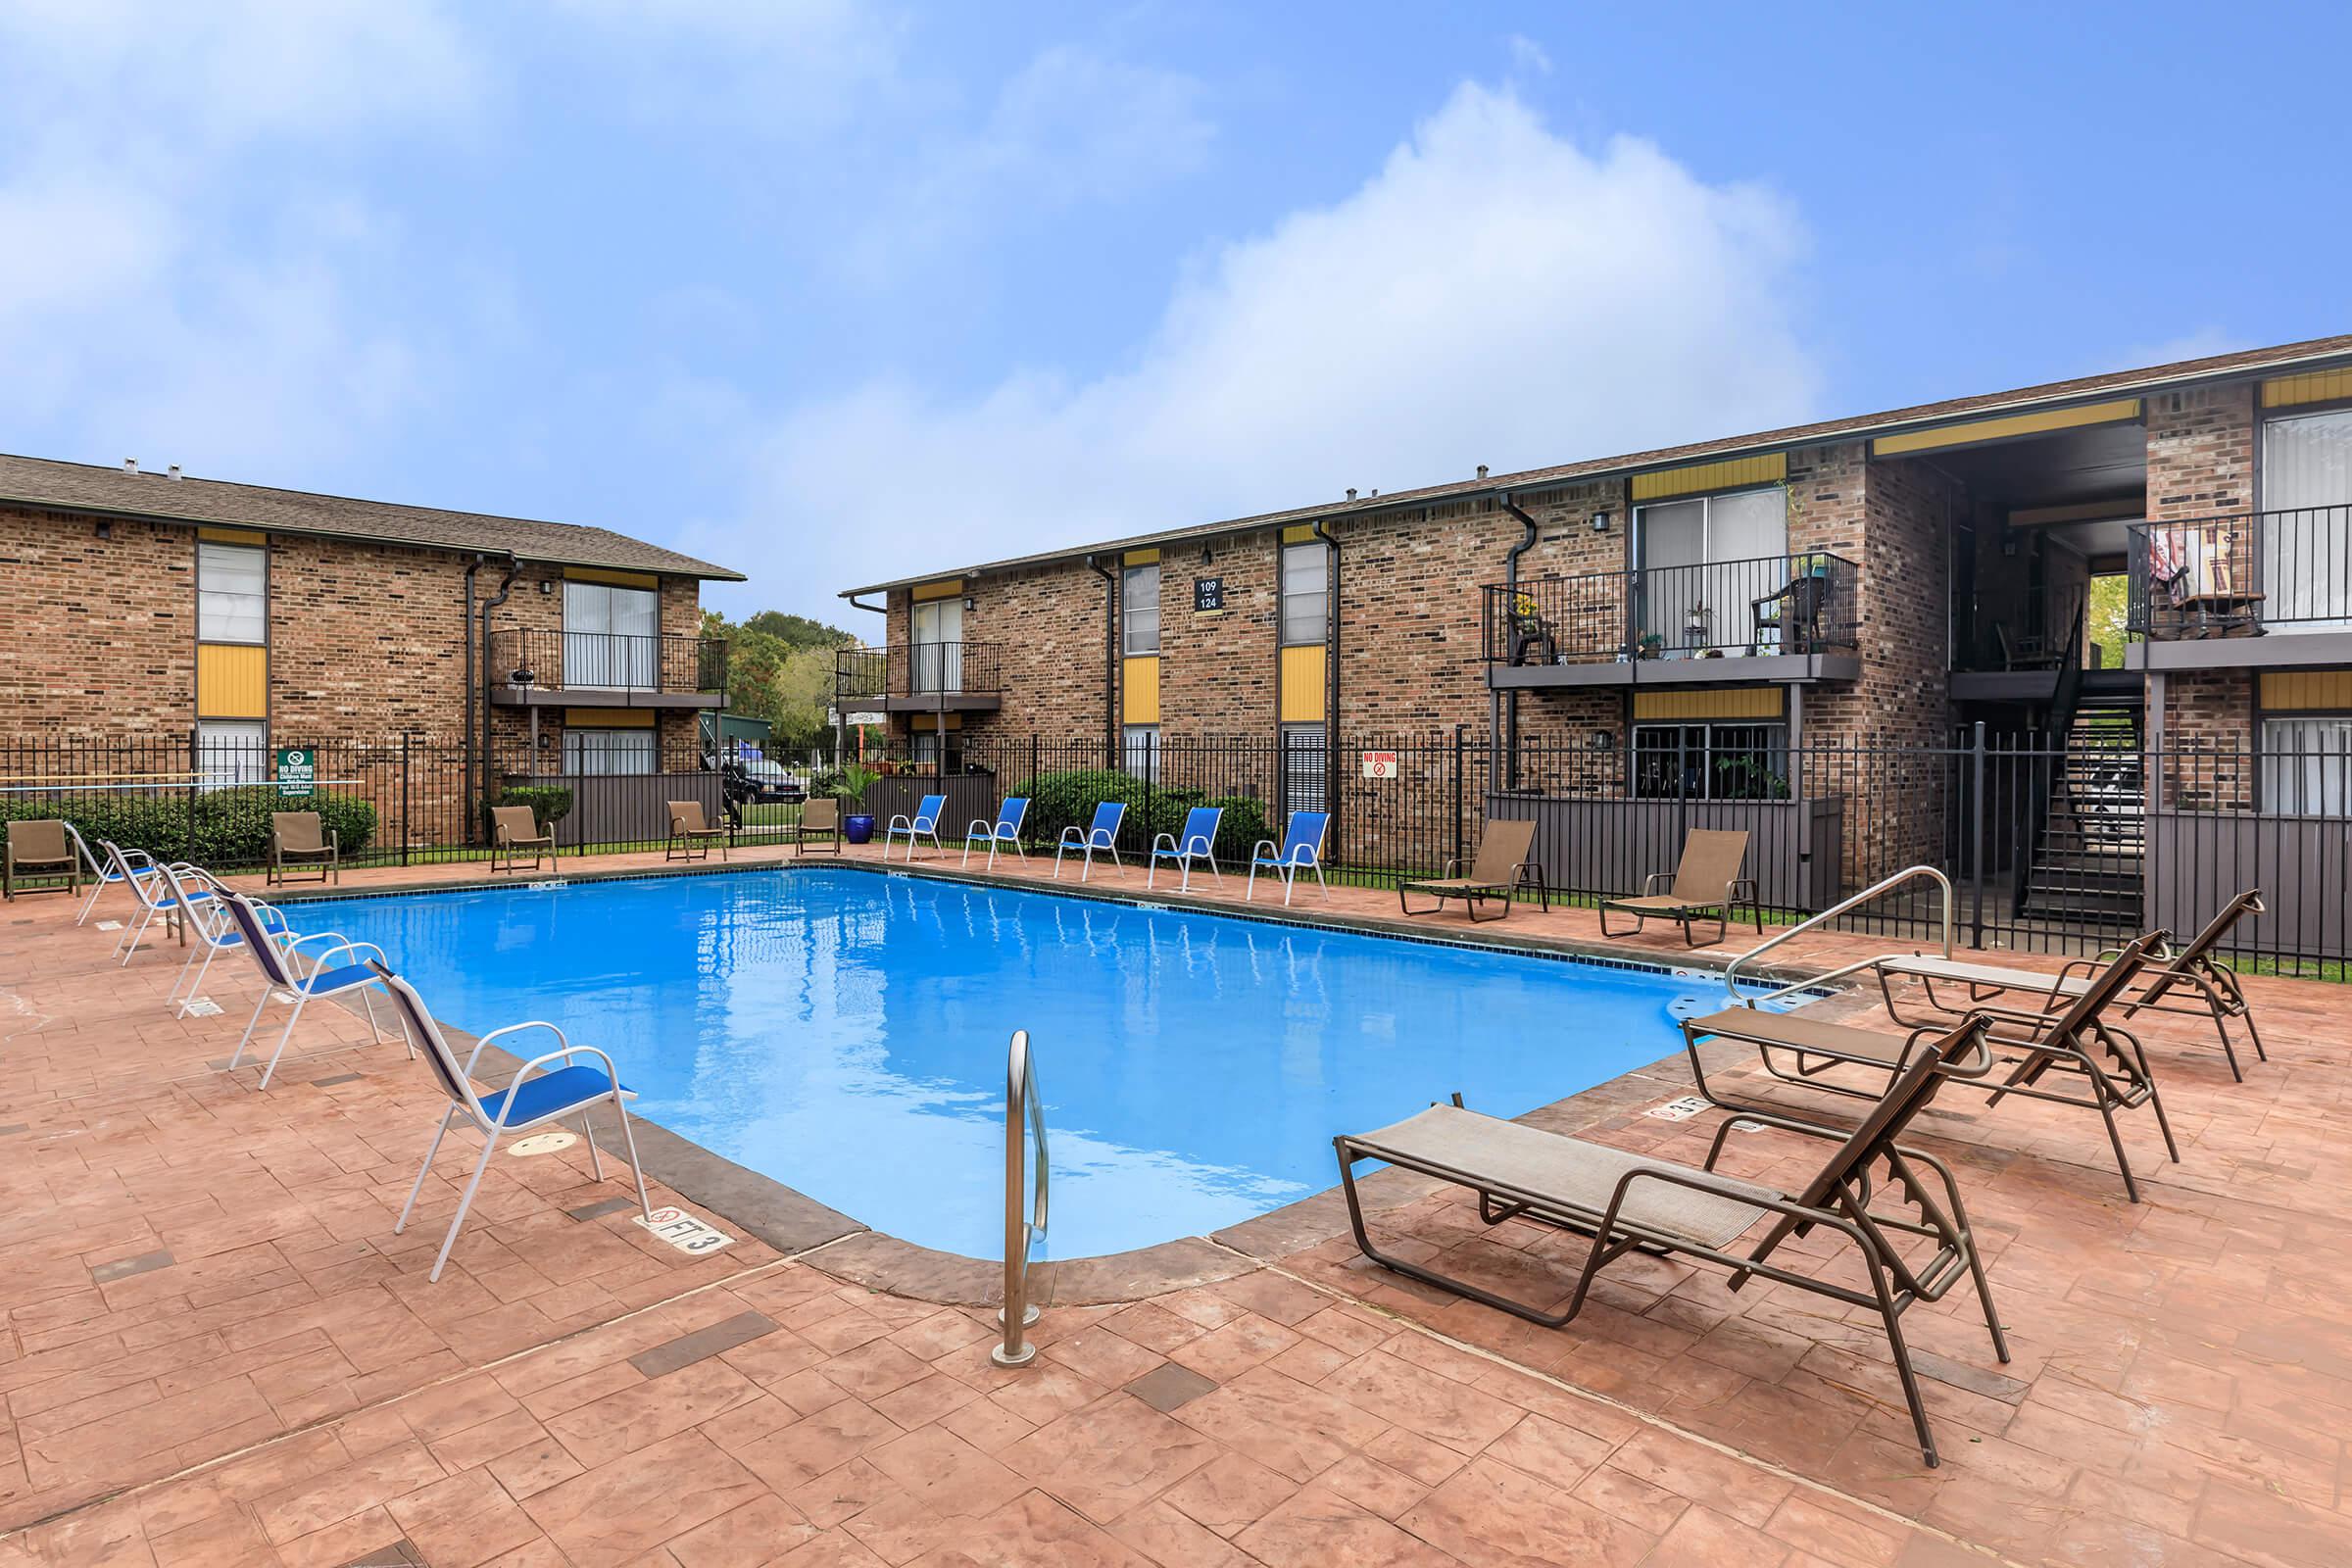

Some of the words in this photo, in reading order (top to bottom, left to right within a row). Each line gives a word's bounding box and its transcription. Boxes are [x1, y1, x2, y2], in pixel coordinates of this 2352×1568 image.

[1200, 581, 1216, 592] 109
[1200, 598, 1216, 609] 124
[1364, 753, 1373, 762] NO
[1375, 753, 1396, 762] DIVING
[659, 1219, 705, 1239] FT
[687, 1236, 720, 1250] 3
